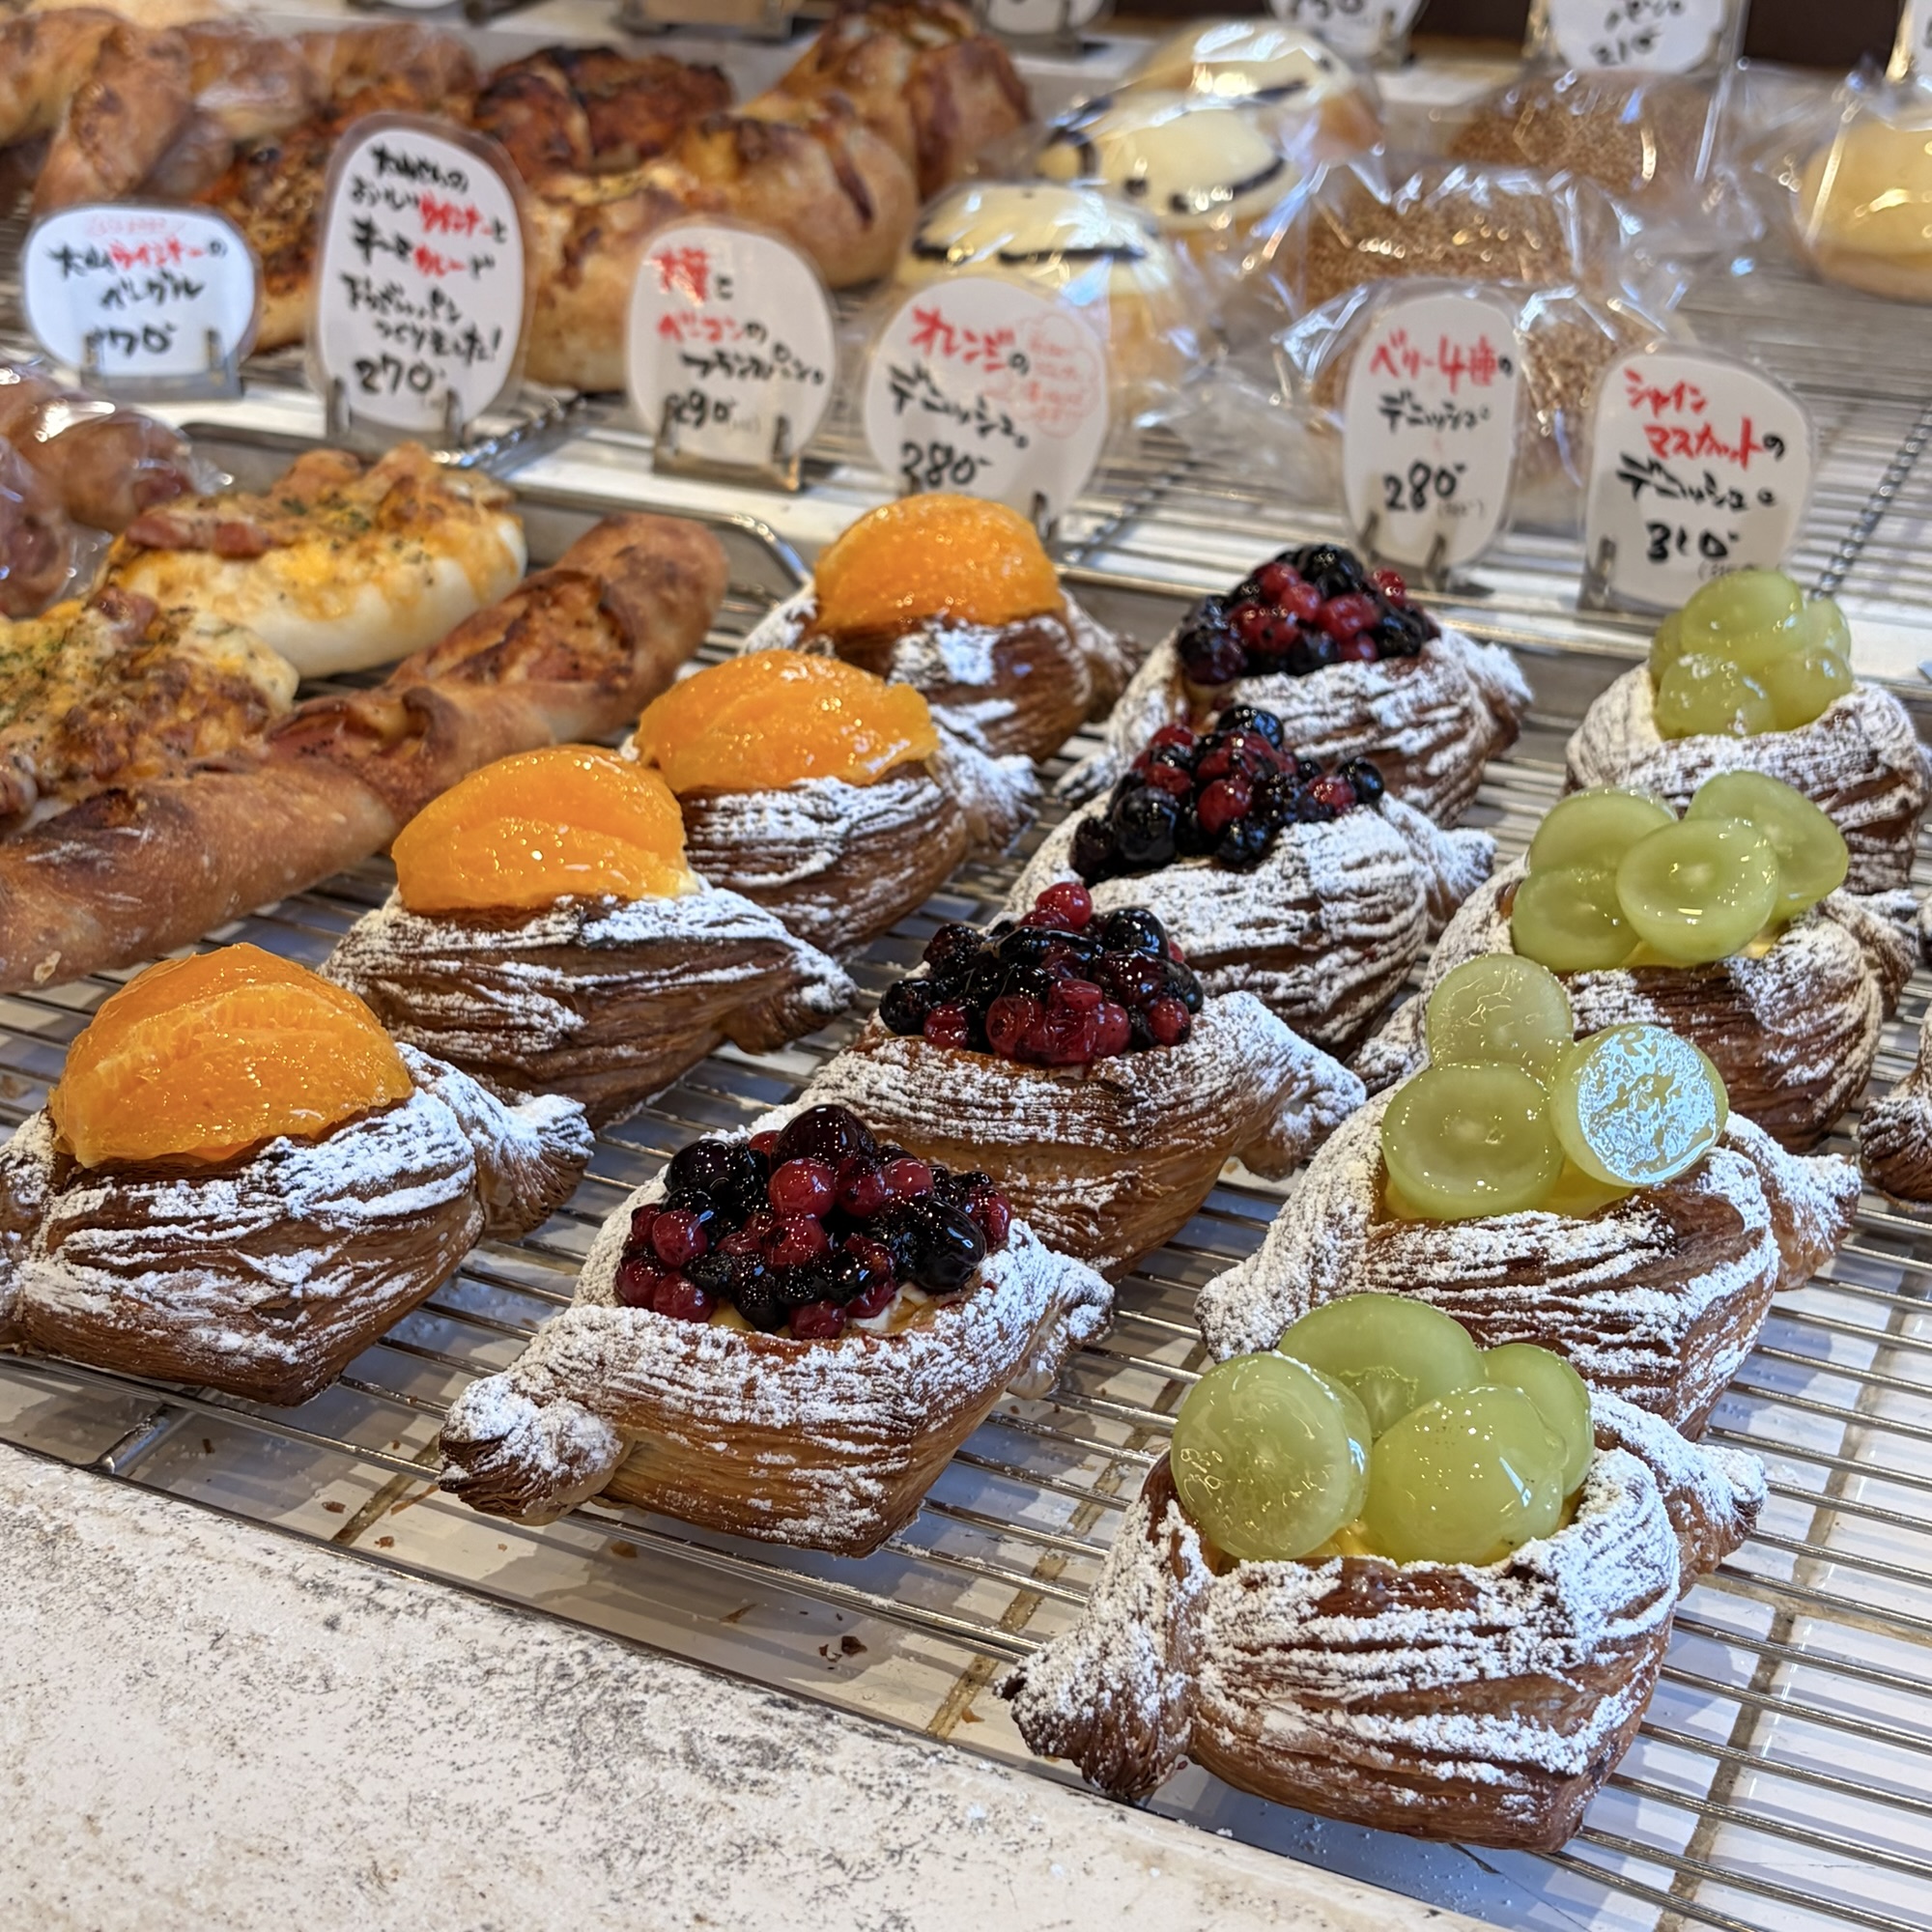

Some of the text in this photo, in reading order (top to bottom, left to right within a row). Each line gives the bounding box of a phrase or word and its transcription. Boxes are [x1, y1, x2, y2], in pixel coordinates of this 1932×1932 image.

[1623, 367, 1708, 417] シャイン
[1642, 415, 1785, 472] マスカットの
